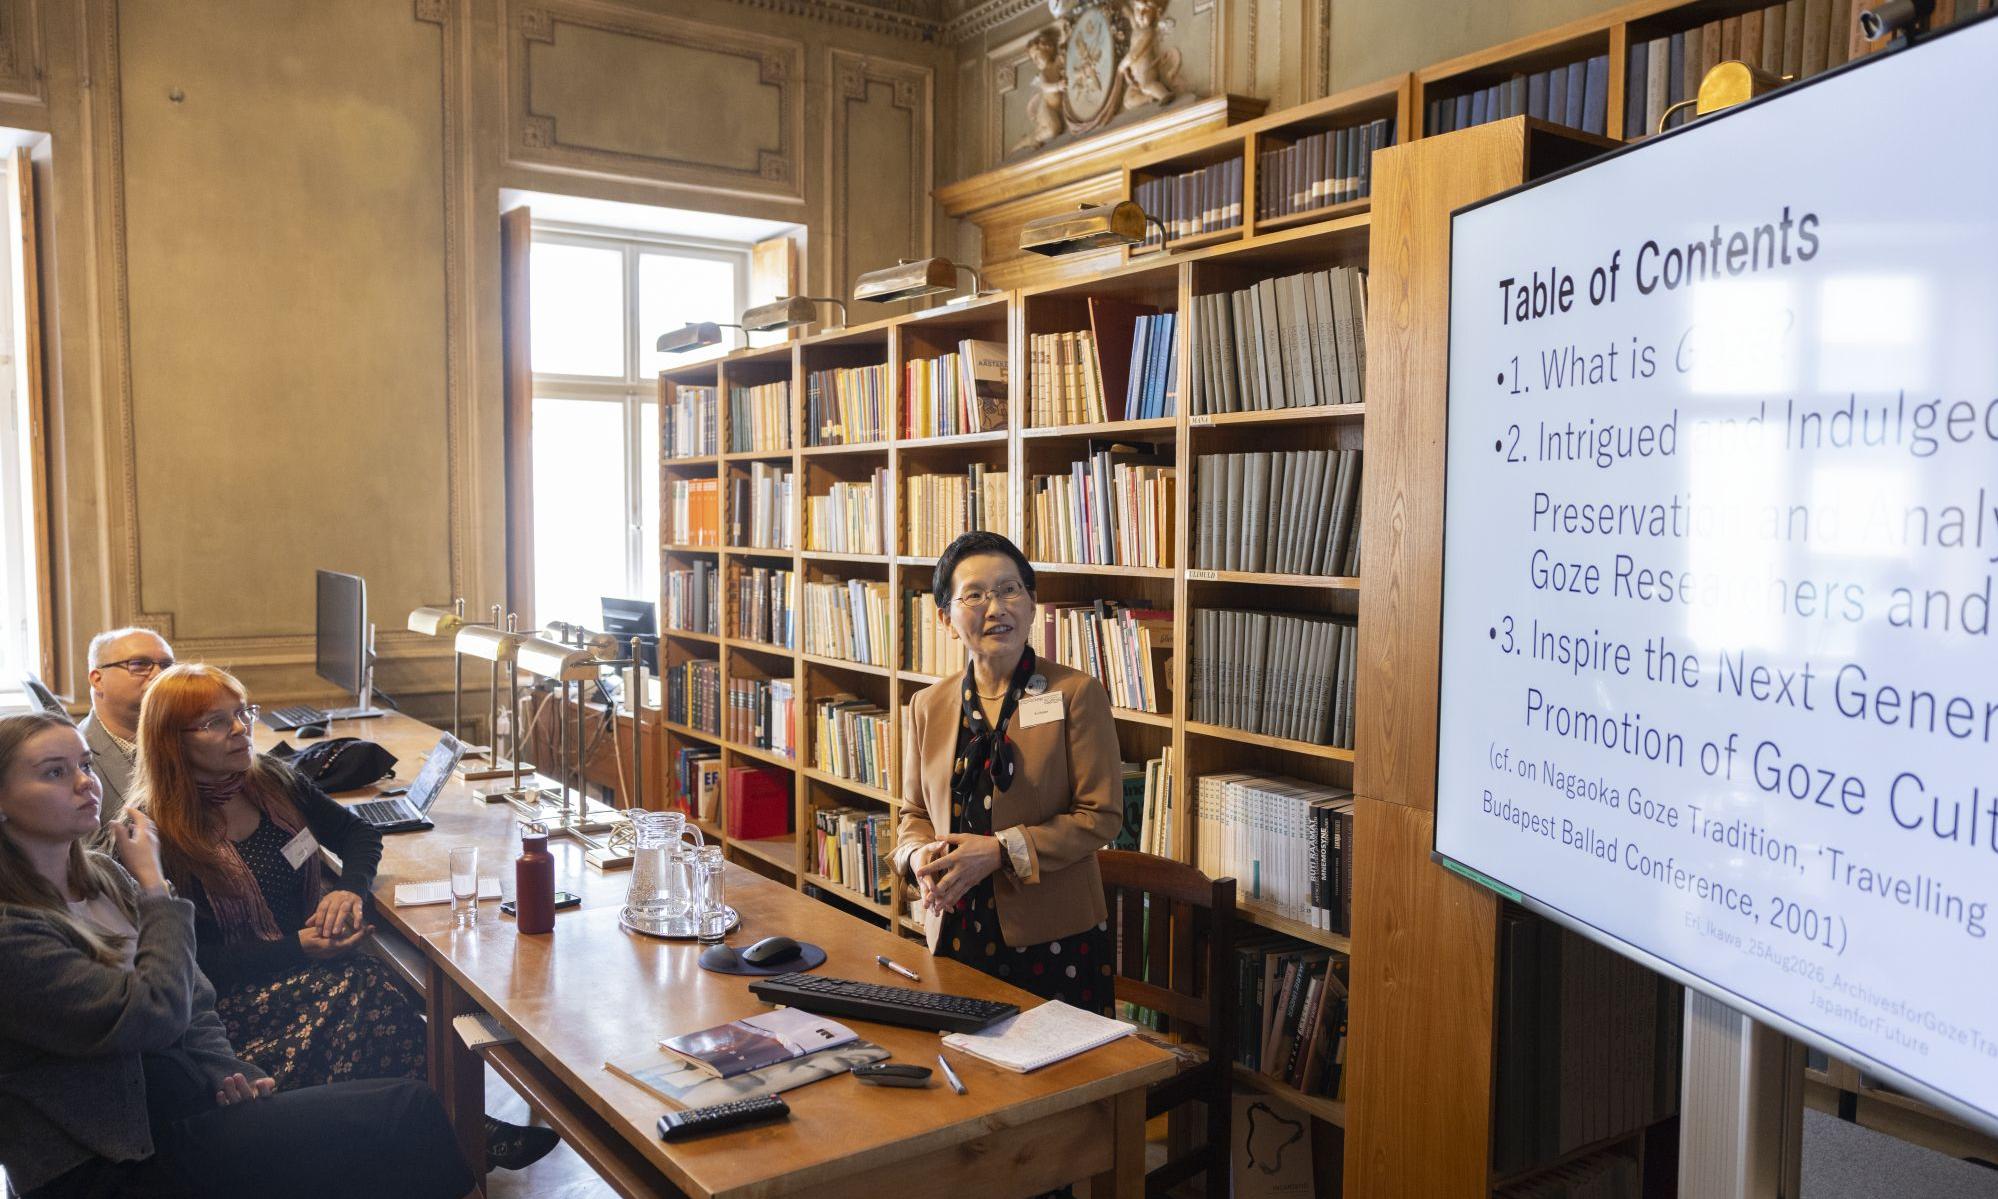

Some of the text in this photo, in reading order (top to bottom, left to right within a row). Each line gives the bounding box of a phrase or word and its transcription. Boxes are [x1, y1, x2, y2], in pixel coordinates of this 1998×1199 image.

[1499, 206, 1821, 326] Table of Contents
[1510, 356, 1530, 395] 1.
[1542, 341, 1619, 391] What
[1631, 337, 1657, 380] is
[1506, 424, 1528, 464] 2.
[1538, 409, 1678, 469] Intrigued
[1862, 485, 1998, 564] Anal
[1530, 548, 1600, 595] Goze
[1887, 575, 1993, 636] and
[1500, 615, 1522, 656] 3.
[1532, 619, 1631, 676] Inspire
[1645, 636, 1700, 690] the
[1717, 648, 1816, 712] Next
[1526, 687, 1684, 769] Promotion
[1700, 734, 1739, 781] of
[1753, 741, 1867, 816] Goze
[1489, 741, 1513, 774] (cf.
[1518, 758, 1537, 781] on
[1543, 760, 1620, 809] Nagaoka
[1628, 787, 1679, 828] Goze
[1687, 804, 1806, 874] Tradition,
[1320, 827, 1328, 881] MNEMOSYNE
[1482, 789, 1848, 957] Budapest Ballad Conference, 2001)
[1808, 990, 1930, 1057] JapanforFuture
